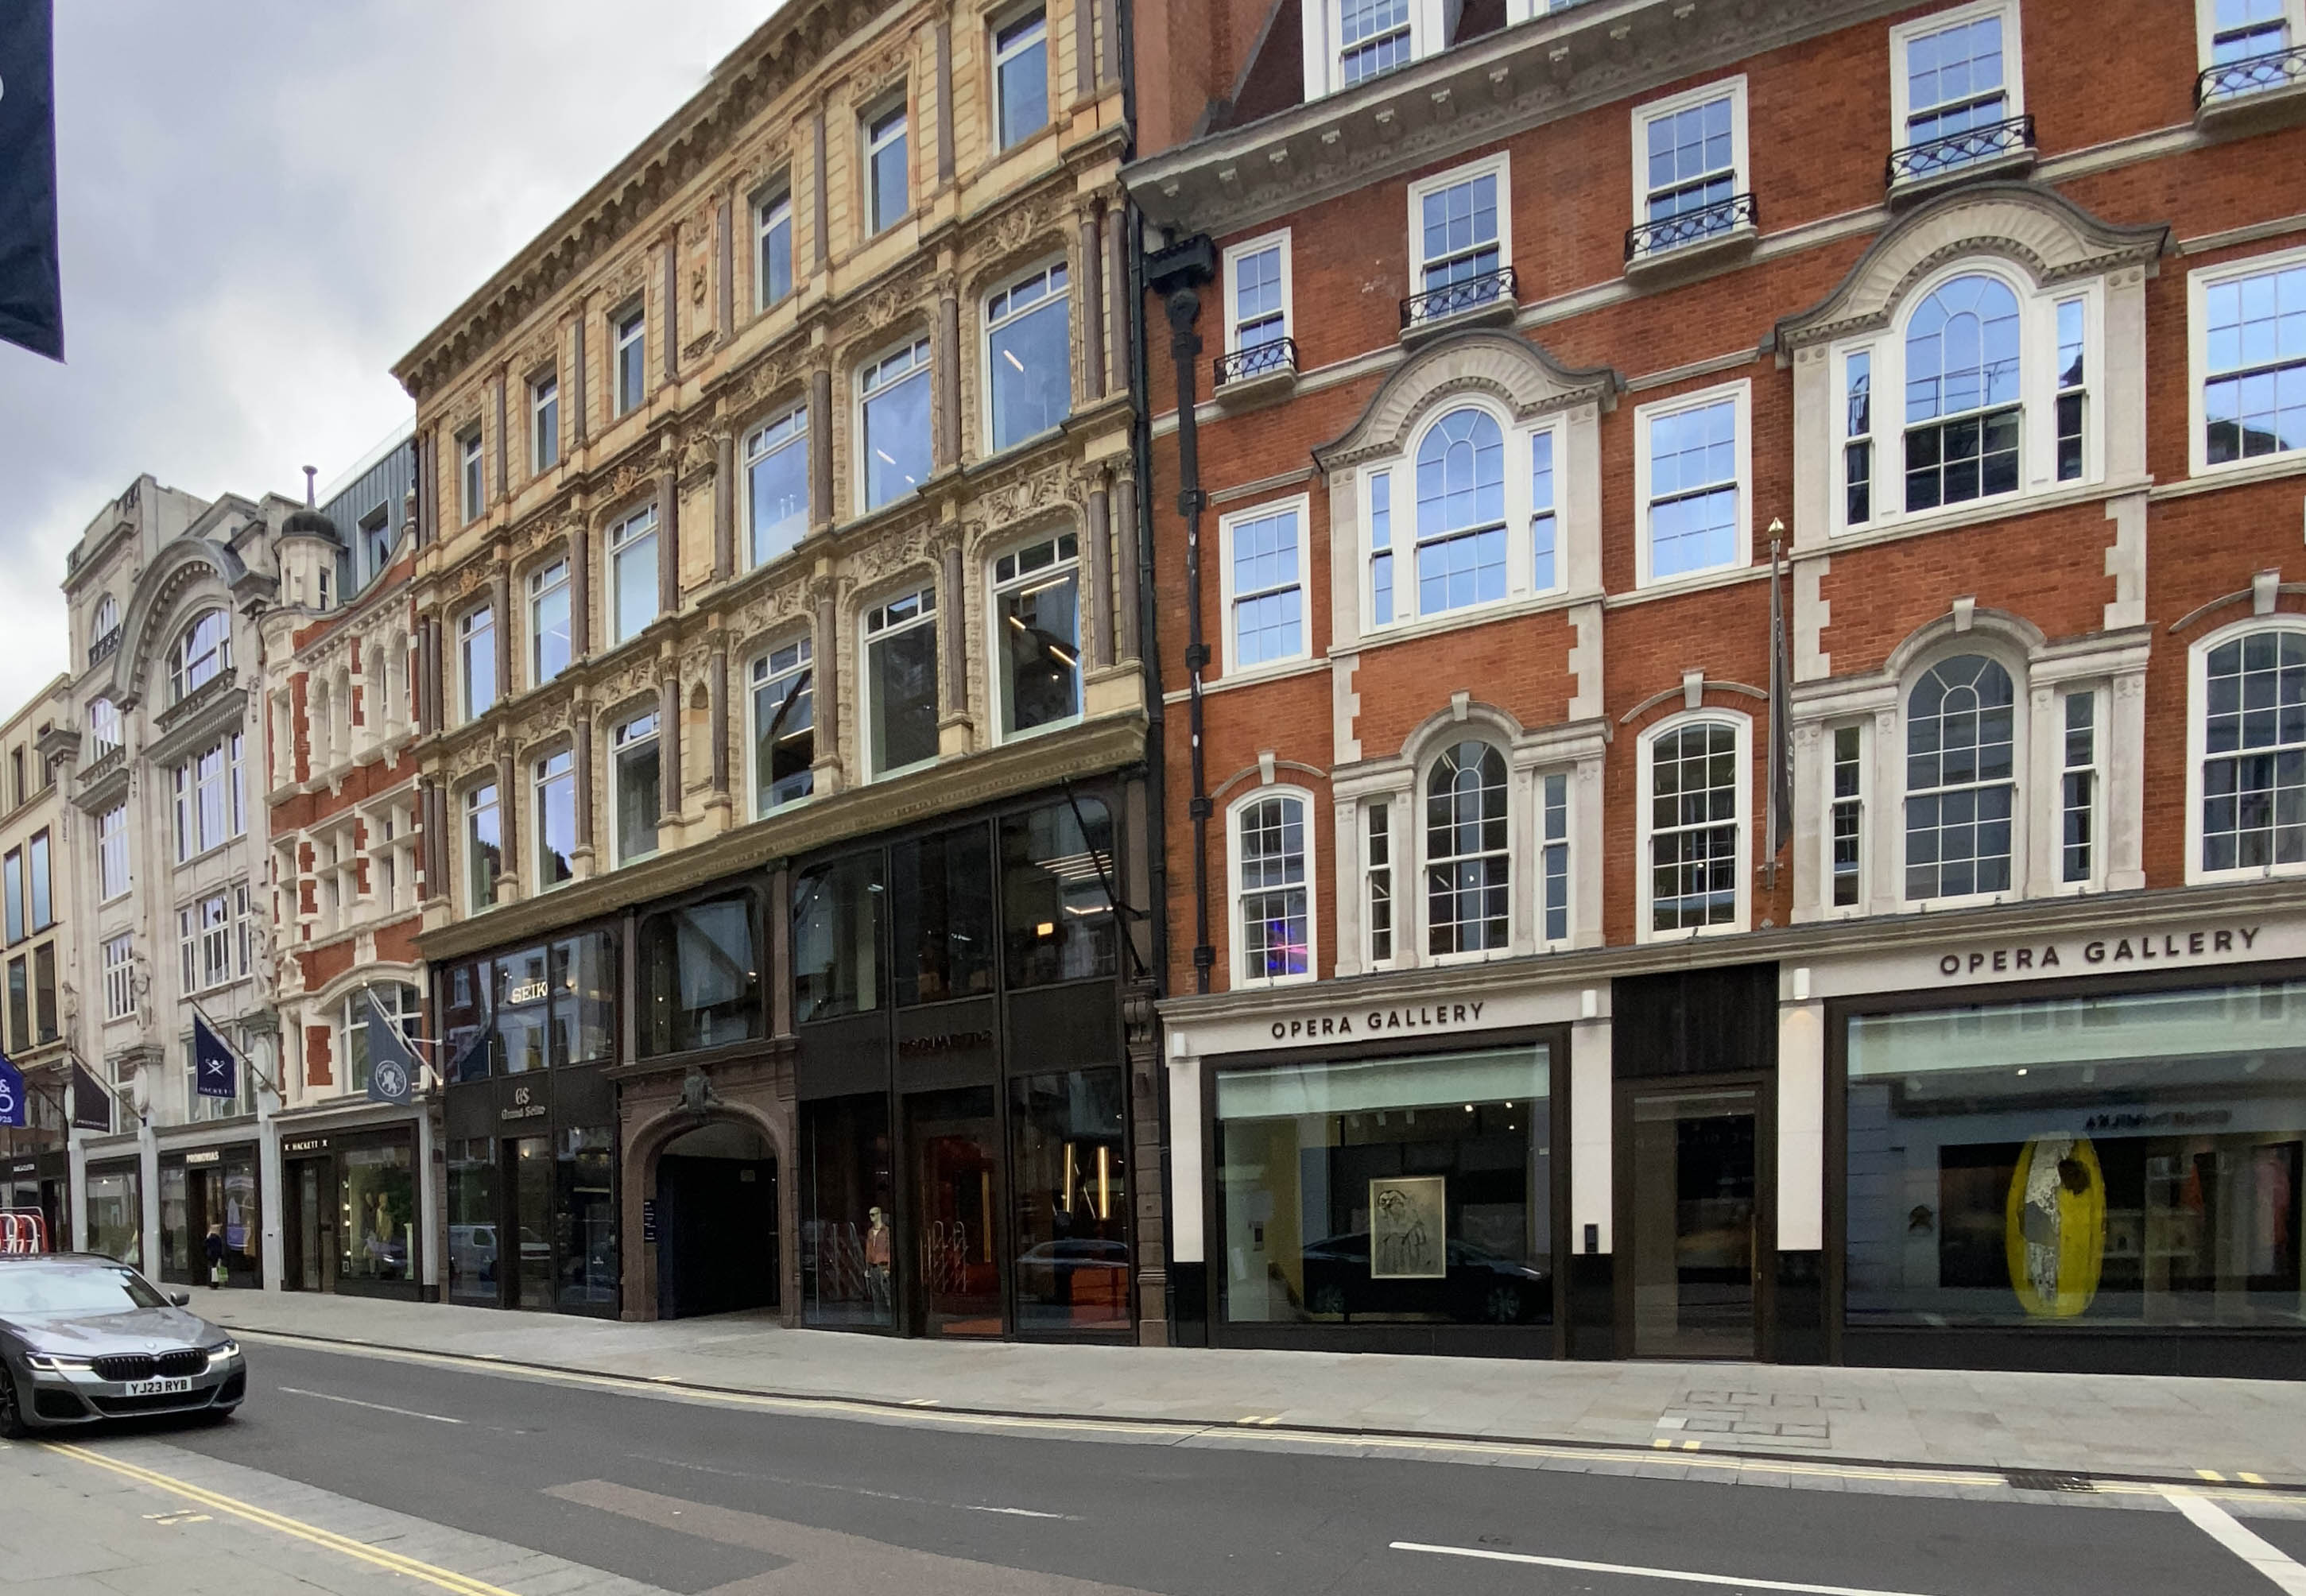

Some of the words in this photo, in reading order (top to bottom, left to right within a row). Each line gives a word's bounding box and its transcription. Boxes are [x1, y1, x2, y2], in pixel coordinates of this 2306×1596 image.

[1940, 946, 2060, 976] OPERA
[2084, 927, 2259, 963] GALLERY
[511, 982, 548, 1004] SEIK
[1272, 1017, 1352, 1040] OPERA
[1367, 1002, 1484, 1030] GALLERY
[293, 1140, 318, 1150] HACKETT
[131, 1381, 162, 1394] YJ23
[165, 1380, 187, 1391] RYB
